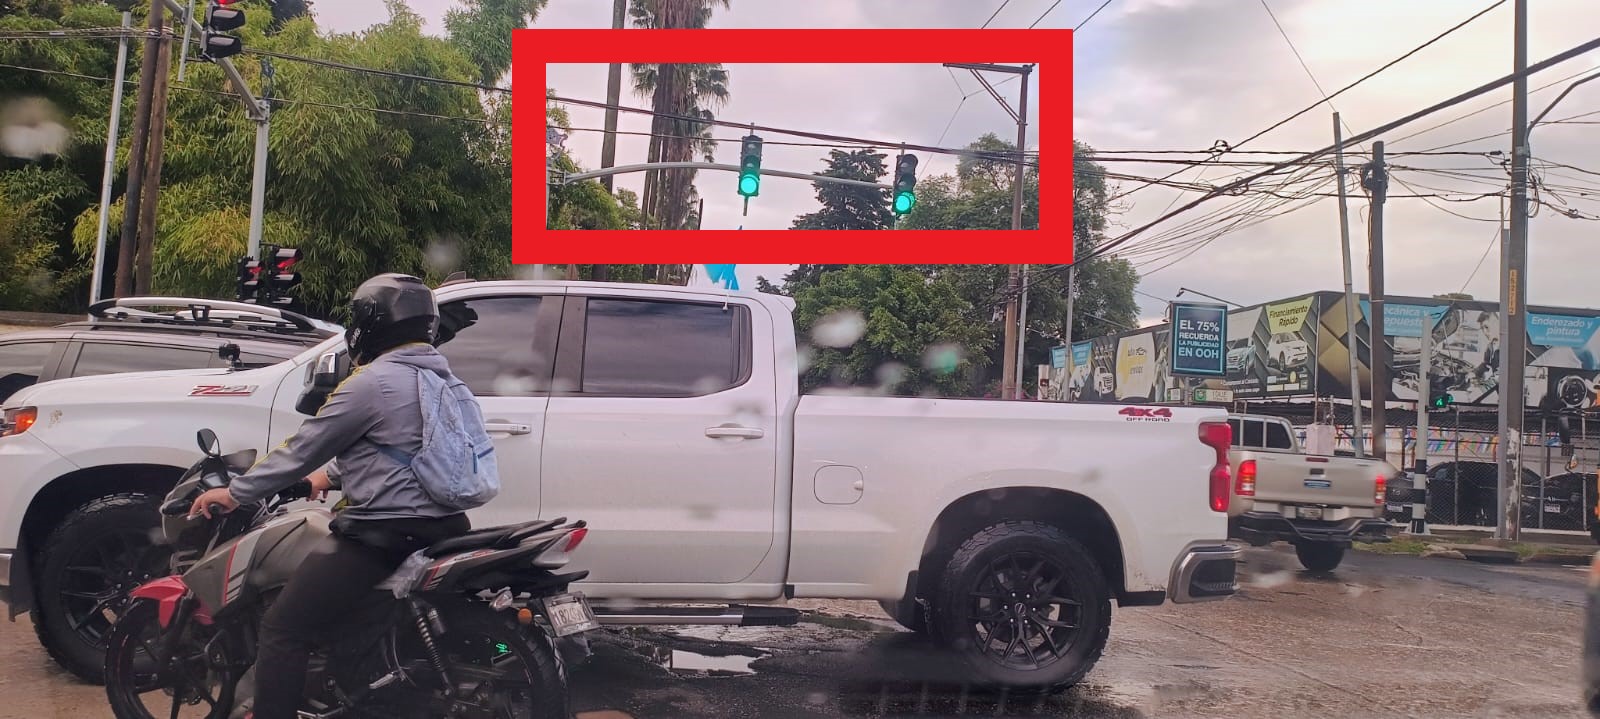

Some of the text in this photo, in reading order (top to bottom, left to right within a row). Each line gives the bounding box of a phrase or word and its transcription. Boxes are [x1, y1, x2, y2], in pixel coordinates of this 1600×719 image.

[1269, 304, 1308, 318] Financiamiento
[1180, 320, 1220, 332] EL 75%
[1531, 316, 1593, 329] Enderezado y
[1179, 332, 1219, 341] RECUERDA
[1546, 327, 1580, 337] pintura
[1187, 340, 1219, 348] PUBLICIDAD
[1178, 347, 1219, 359] EN OOH
